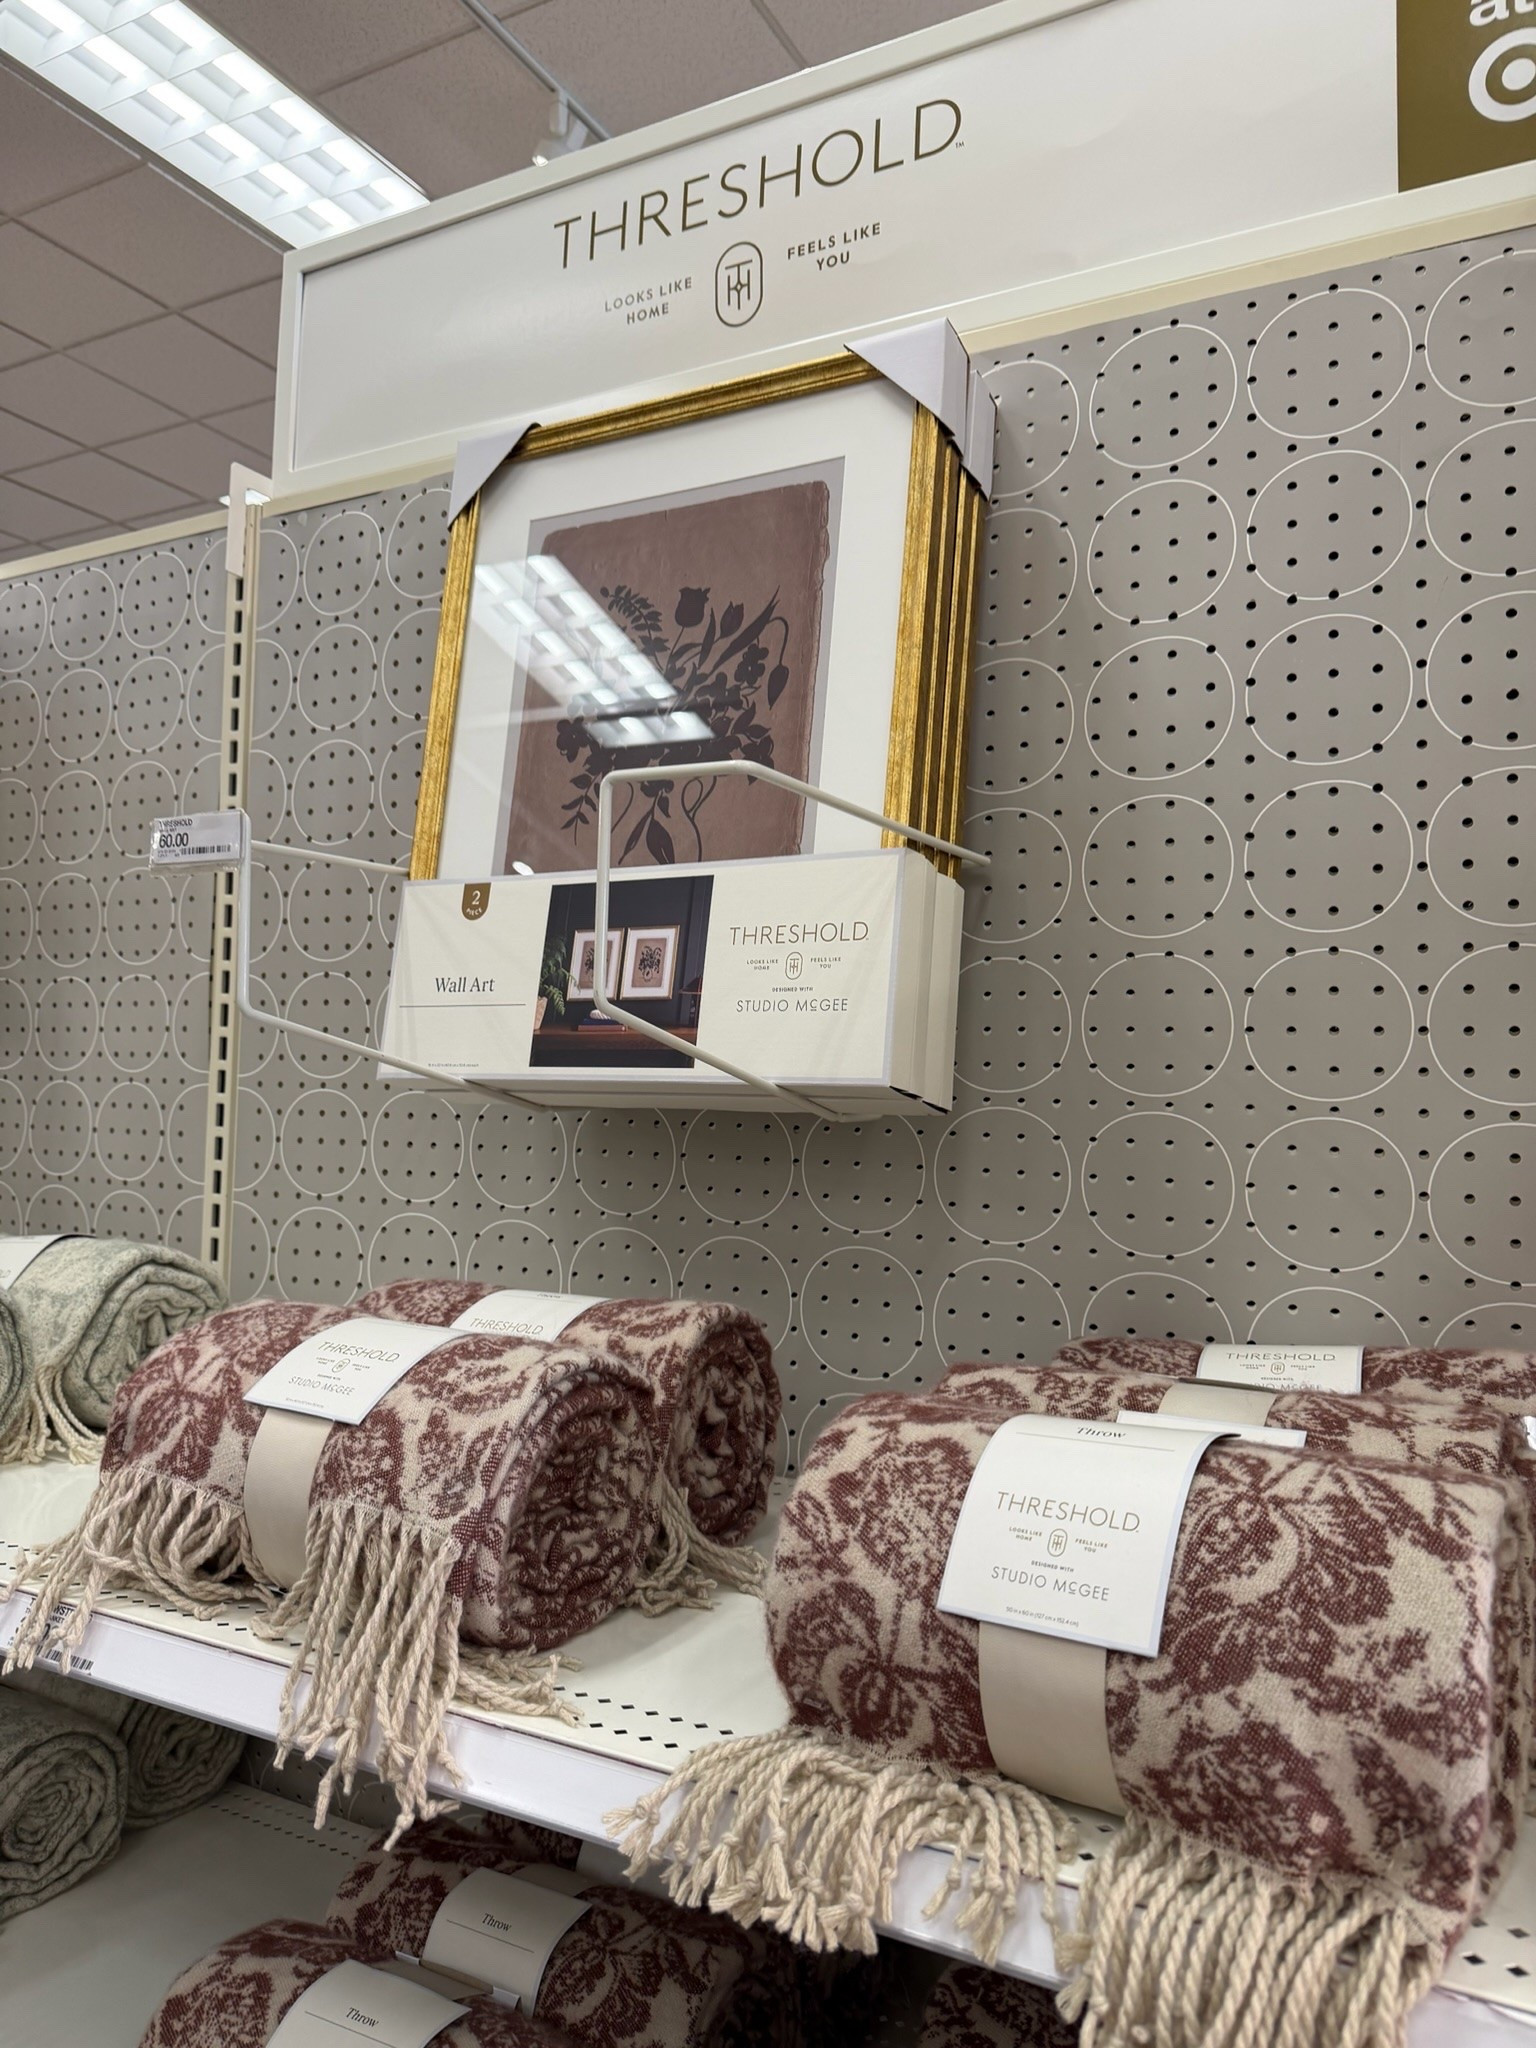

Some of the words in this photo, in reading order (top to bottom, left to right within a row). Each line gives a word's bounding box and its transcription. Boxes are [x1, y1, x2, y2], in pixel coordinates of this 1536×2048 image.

[553, 98, 962, 269] THRESHOLD
[787, 235, 836, 260] FEELS
[843, 222, 881, 244] LIKE
[816, 251, 850, 271] YOU
[605, 289, 654, 312] LOOKS
[660, 277, 693, 297] LIKE
[626, 302, 669, 325] HOME
[159, 833, 189, 848] 60.00
[472, 890, 481, 905] 2
[730, 921, 869, 946] THRESHOLD
[435, 977, 467, 993] Wall
[469, 977, 495, 992] Art
[736, 999, 789, 1012] STUDIO
[470, 1318, 544, 1335] THRESHOLD
[318, 1341, 400, 1363] THRESHOLD
[1226, 1352, 1336, 1361] THRESHOLD
[288, 1376, 321, 1389] STUDIO
[1077, 1427, 1126, 1438] Throw
[998, 1491, 1140, 1532] THRESHOLD
[1031, 1560, 1058, 1570] DESIGNED
[1059, 1564, 1074, 1573] WITH
[991, 1566, 1047, 1588] STUDIO
[482, 1913, 512, 1933] Throw
[346, 2007, 379, 2028] Throw
